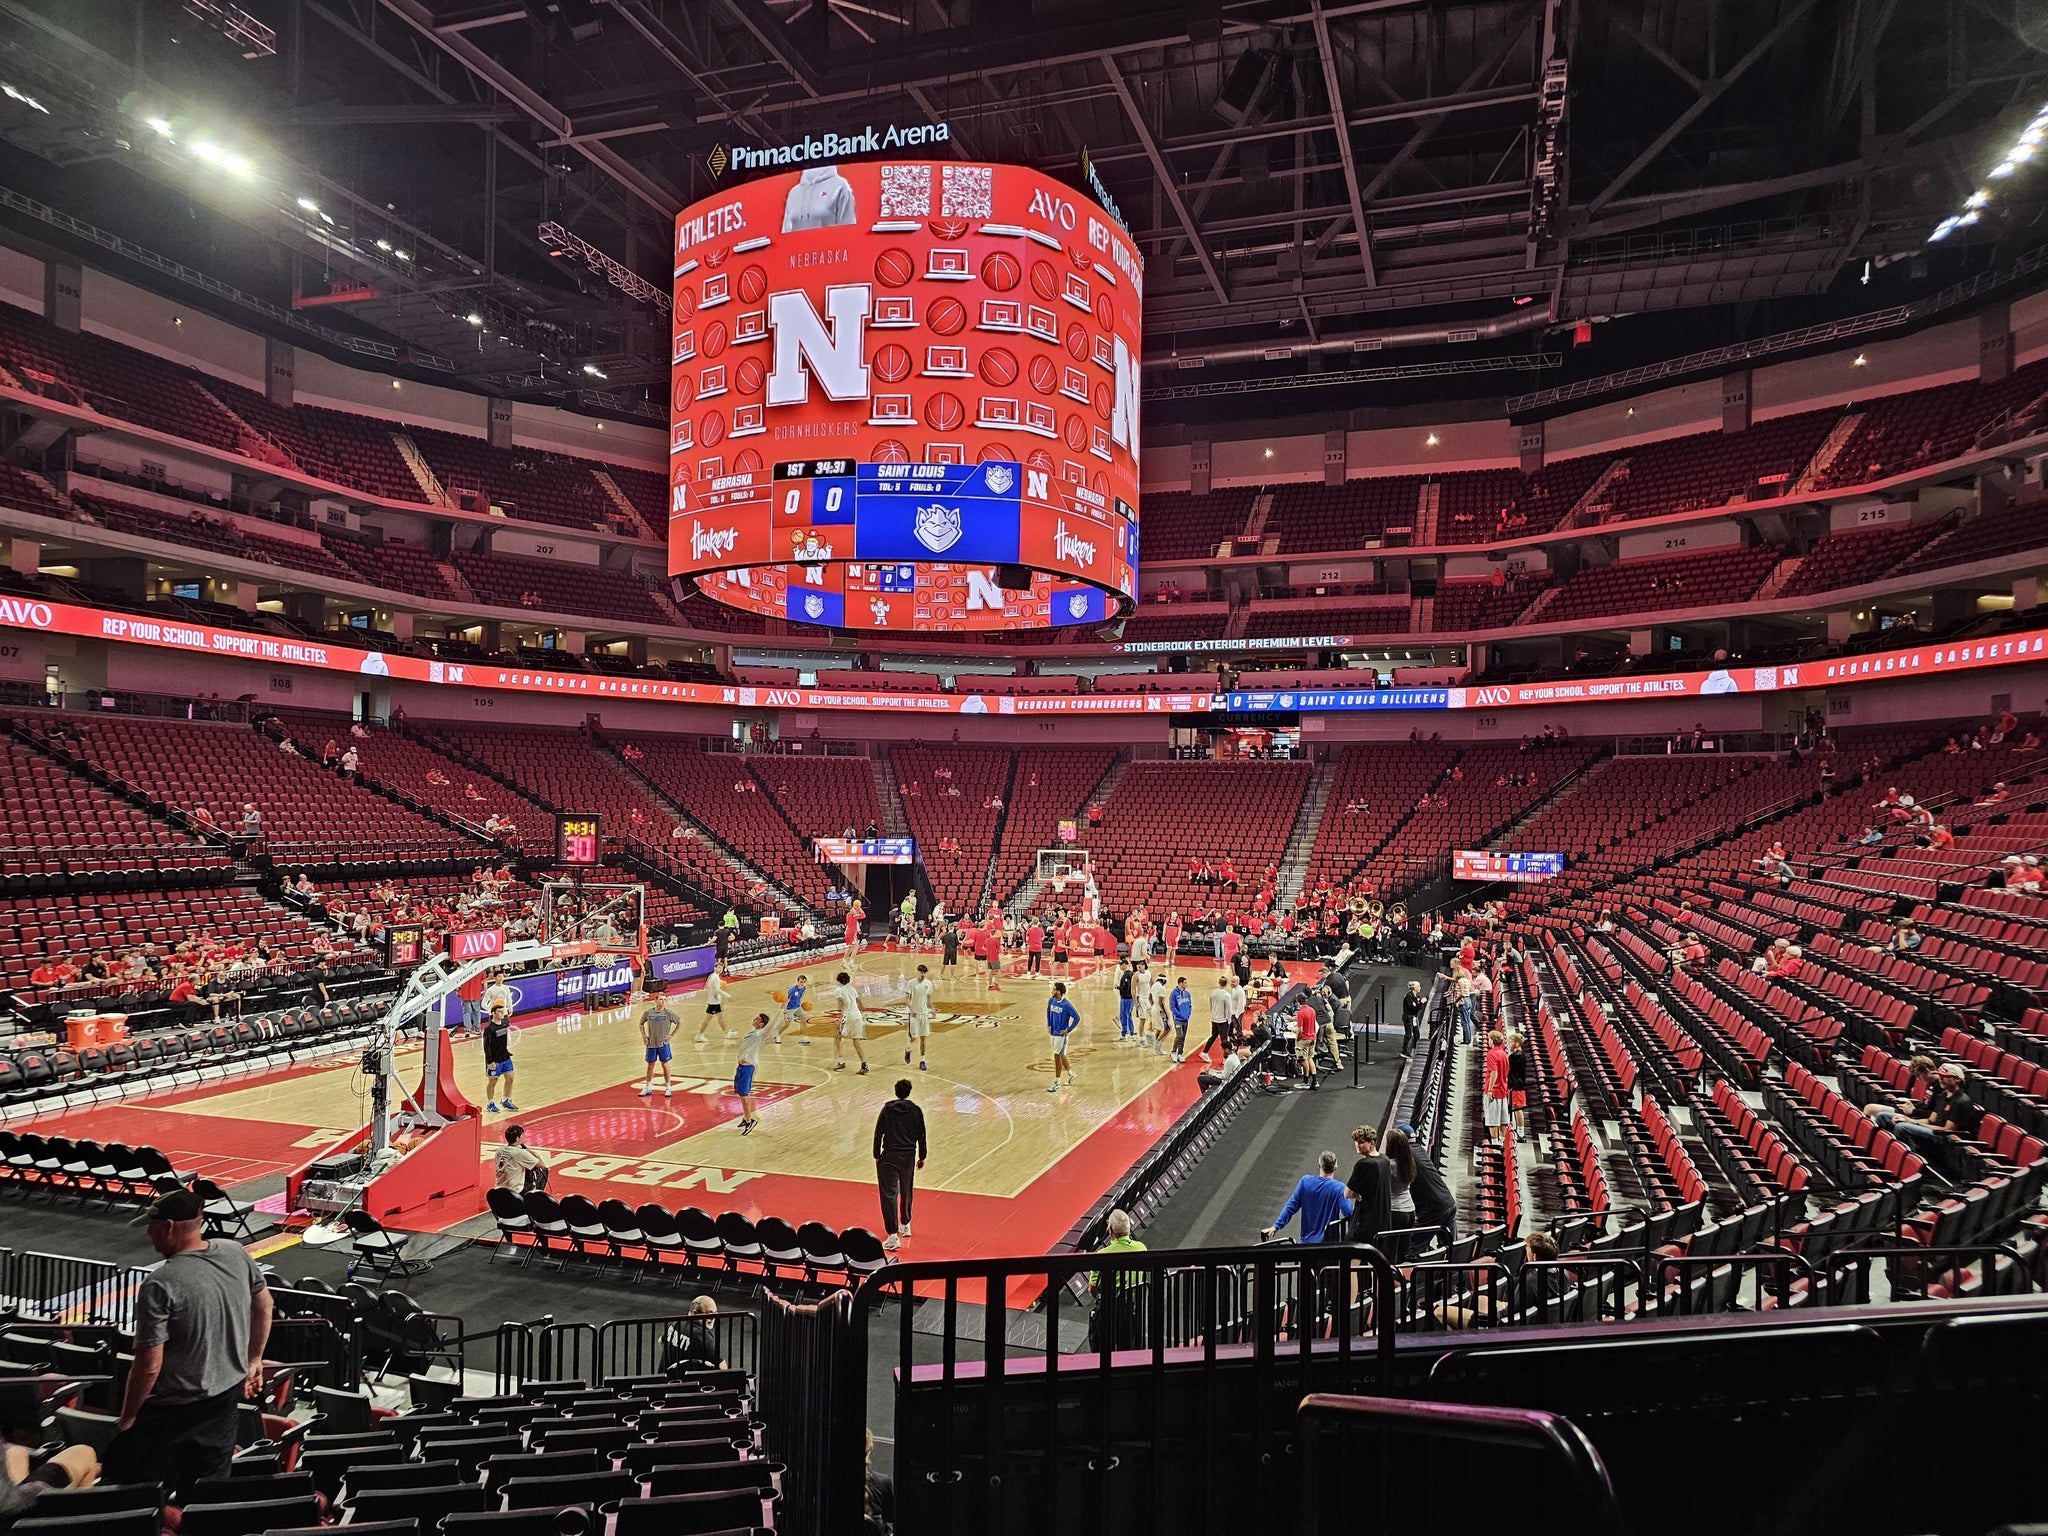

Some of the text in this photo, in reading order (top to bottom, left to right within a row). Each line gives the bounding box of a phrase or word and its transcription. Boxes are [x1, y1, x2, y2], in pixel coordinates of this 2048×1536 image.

[731, 121, 949, 170] PinnacleBank Arena
[1028, 187, 1077, 231] AVO
[678, 202, 747, 252] ATHLETES.
[1088, 216, 1110, 253] REP
[790, 249, 849, 268] NEBRASKA
[57, 283, 80, 299] 305
[766, 282, 873, 407] N
[273, 366, 294, 378] 306
[493, 411, 511, 422] 307
[774, 421, 859, 440] CORNHUSKERS
[1522, 436, 1541, 446] 313
[1326, 453, 1343, 461] 312
[787, 460, 845, 476] 1ST 34:31
[878, 465, 945, 478] SAINT LOUIS
[1192, 463, 1208, 471] 311
[712, 474, 753, 491] NEBRASKA
[909, 482, 934, 492] FOULS:
[1027, 469, 1049, 500] N
[673, 484, 687, 512] N
[784, 489, 800, 514] 0
[825, 487, 843, 512] 0
[328, 511, 346, 523] 206
[1861, 509, 1885, 521] 215
[690, 519, 739, 560] Huskers
[1054, 518, 1096, 569] Huskers
[1666, 538, 1687, 549] 214
[536, 545, 554, 556] 207
[849, 565, 861, 577] N
[1508, 560, 1526, 570] 213
[1321, 572, 1339, 580] 212
[966, 570, 1004, 610] N
[0, 599, 52, 627] AVO
[103, 617, 328, 664] REP YOUR SCHOOL. SUPPORT THE ATHLETES.
[1123, 636, 1337, 652] STONEBROOK EXTERIOR PREMIUM LEVEL
[448, 666, 463, 682] N
[1827, 655, 1919, 678] NEBRASKA
[272, 678, 291, 689] 108
[1783, 668, 1798, 685] N
[499, 673, 697, 698] NEBRASKA BASKETBALL
[1519, 679, 1686, 700] REP YOUR SCHOOL. SUPPORT THE ATHLETES.
[474, 698, 494, 708] 109
[723, 688, 736, 703] N
[765, 690, 801, 705] AVO
[808, 694, 950, 709] REP YOUR SCHOOL. SUPPORT THE ATHLETES.
[1147, 697, 1161, 710] N
[1197, 696, 1206, 708] 0
[1234, 696, 1242, 708] 0
[1300, 692, 1446, 706] SAINT LOUIS BILLIKENS
[1475, 688, 1511, 704] AVO
[1017, 699, 1142, 709] NEBRASKA CORNHUSKERS
[1831, 700, 1849, 711] 114
[1219, 712, 1281, 722] CURRENCY
[1478, 717, 1497, 727] 113
[1039, 723, 1055, 731] 111
[566, 836, 593, 861] 30
[462, 932, 497, 955] AVO
[397, 945, 413, 962] 30
